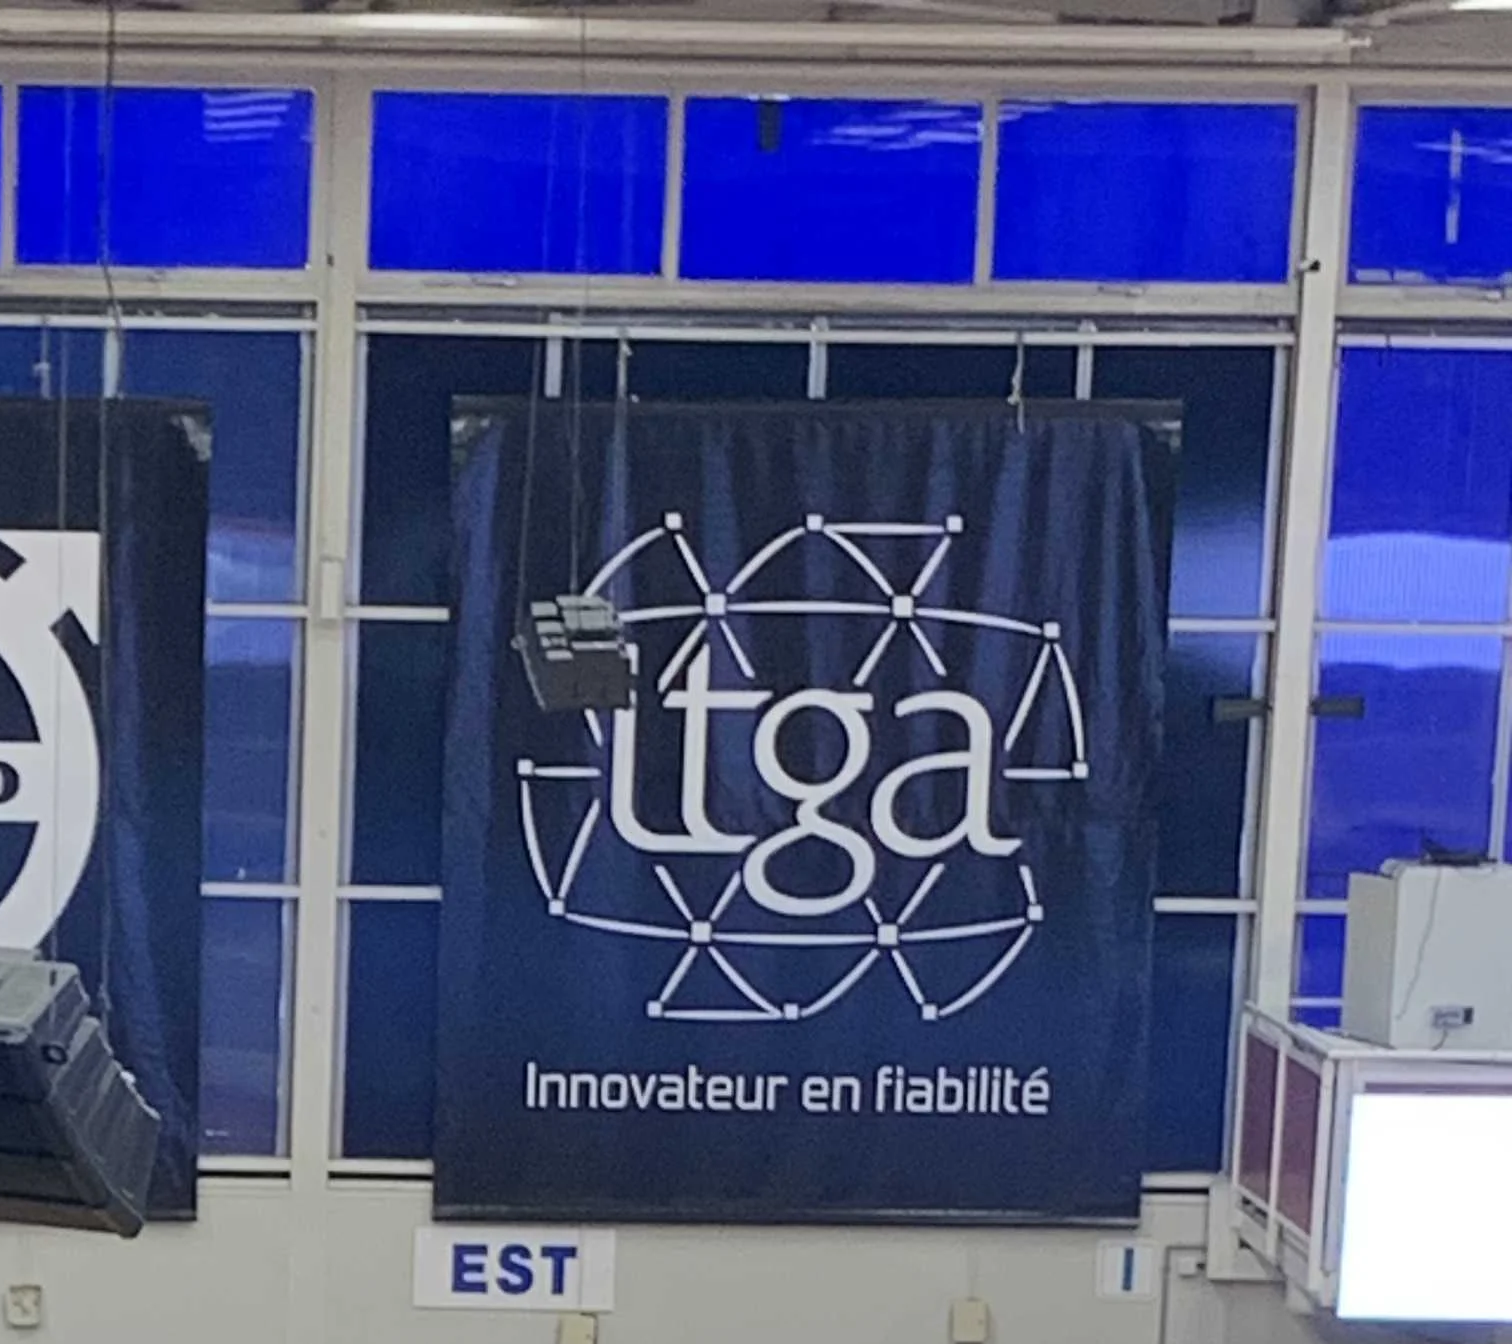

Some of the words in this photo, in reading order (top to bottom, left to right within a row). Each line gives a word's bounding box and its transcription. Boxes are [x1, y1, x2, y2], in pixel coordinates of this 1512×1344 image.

[525, 1061, 788, 1113] Innovateur
[802, 1075, 860, 1114] en
[875, 1063, 1052, 1117] fiabilité
[450, 1244, 578, 1296] EST
